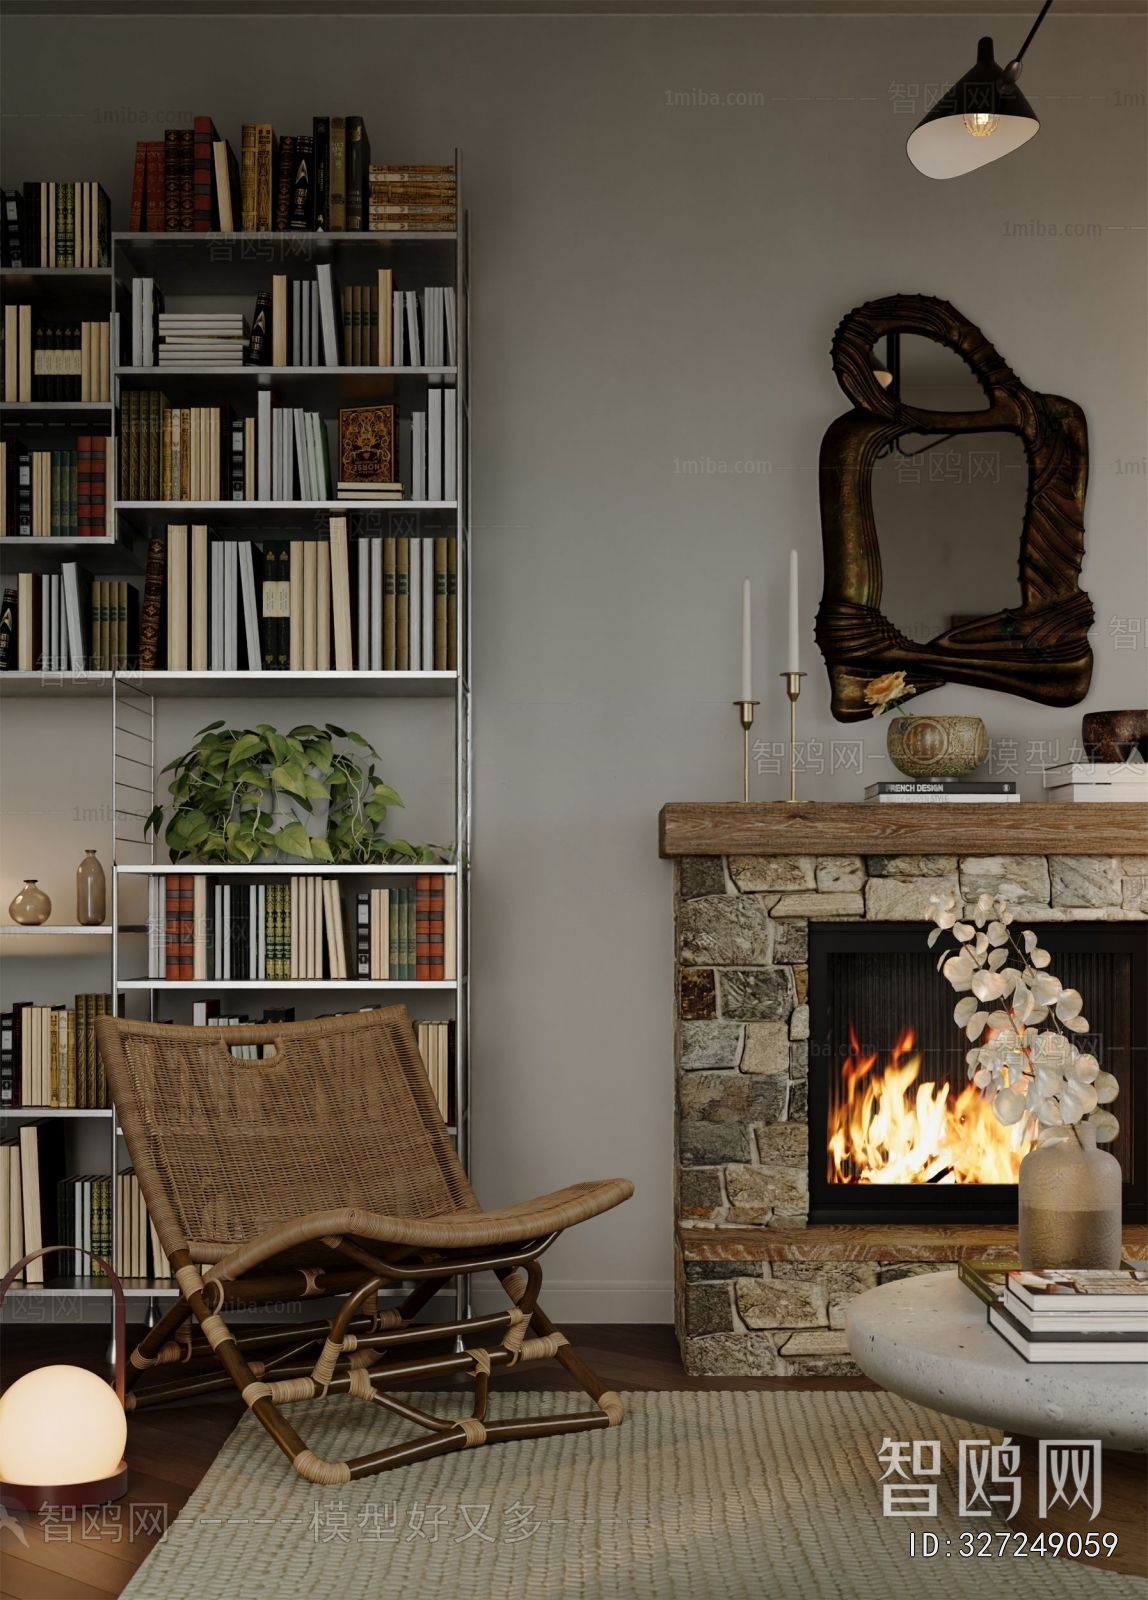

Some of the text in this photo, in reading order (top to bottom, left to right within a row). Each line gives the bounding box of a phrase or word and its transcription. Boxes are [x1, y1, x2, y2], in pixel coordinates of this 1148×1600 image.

[352, 463, 380, 471] NORSE
[885, 783, 944, 793] FRENCH DESIGN
